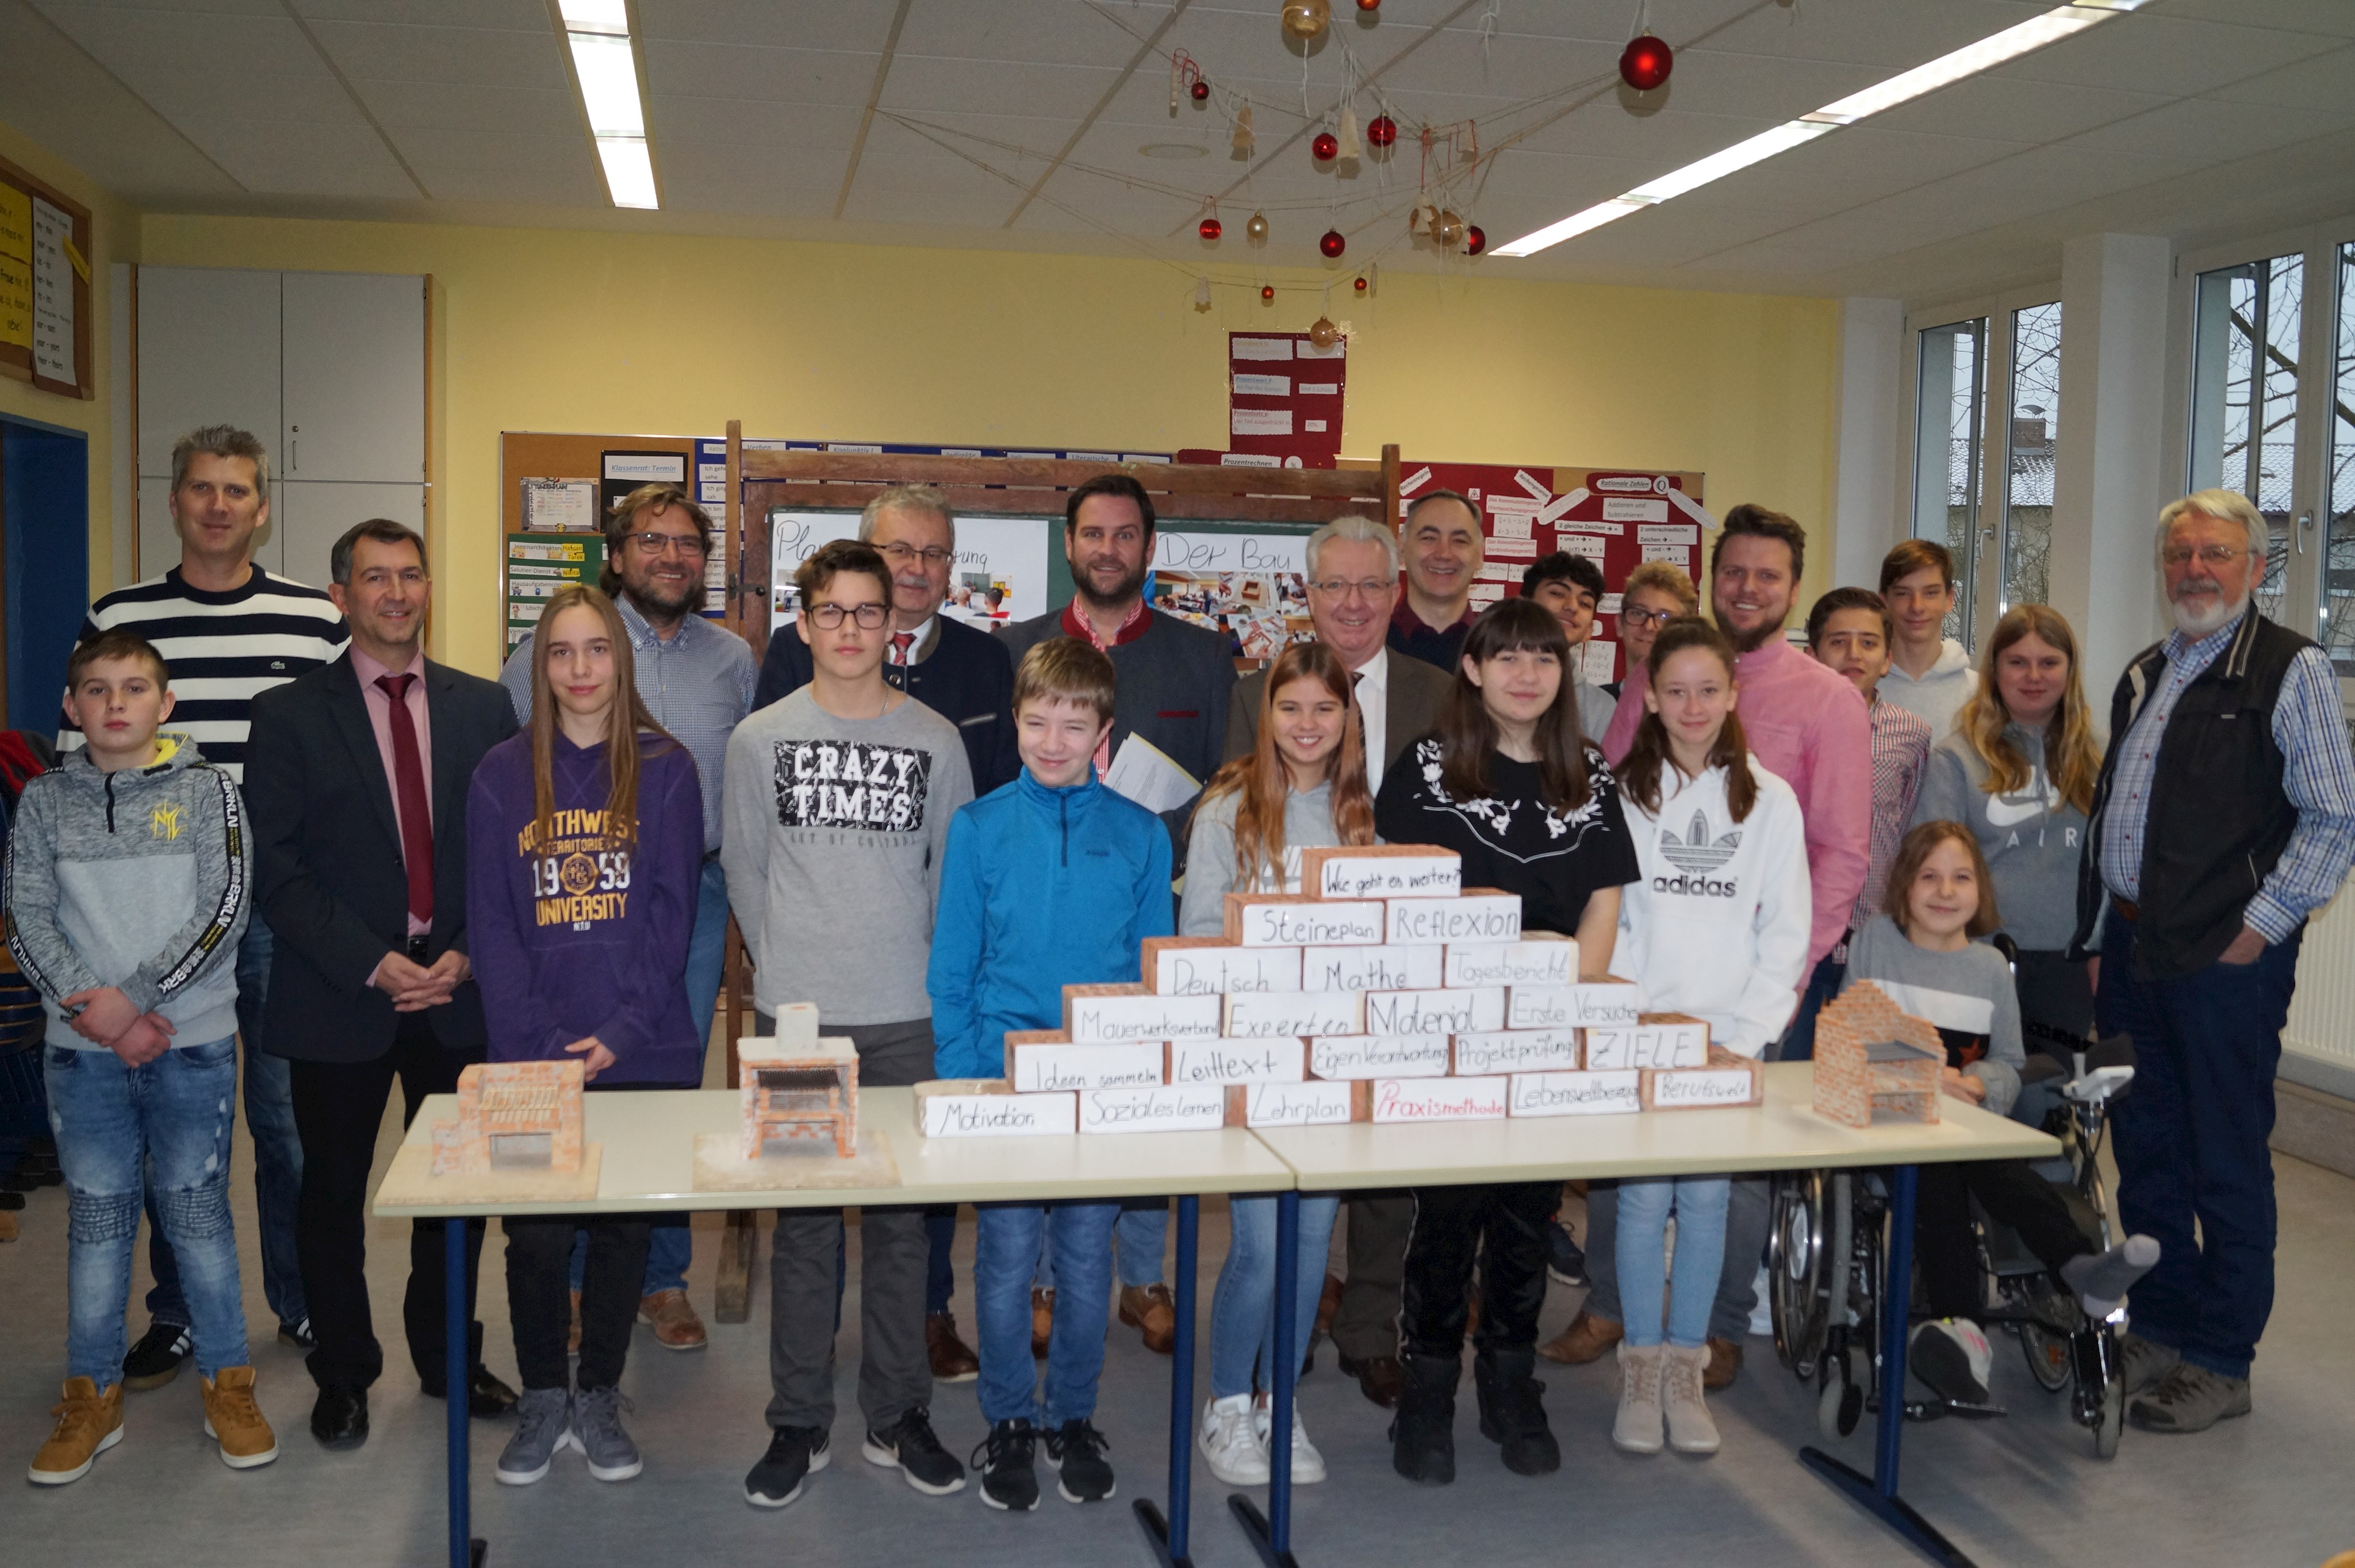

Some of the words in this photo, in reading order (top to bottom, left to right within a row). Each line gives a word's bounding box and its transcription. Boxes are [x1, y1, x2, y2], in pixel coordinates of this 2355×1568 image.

[1223, 458, 1272, 467] Prozentrechnen
[1629, 480, 1650, 488] Zahlen
[1159, 532, 1226, 569] Der
[1242, 538, 1290, 569] Bau
[795, 746, 914, 787] CRAZY
[792, 785, 912, 825] TIMES
[2006, 827, 2077, 848] AIR
[1326, 864, 1350, 894] Wie
[1356, 869, 1383, 896] geht
[1389, 875, 1403, 888] es
[1654, 875, 1736, 897] adidas
[535, 892, 628, 927] UNIVERSITY
[1262, 910, 1375, 942] Steineplan
[1396, 906, 1518, 938] Reflexion
[1174, 957, 1269, 995] Deutsch
[1325, 959, 1407, 990] Mathe
[1451, 948, 1569, 984] Tagesbericht
[1230, 1003, 1349, 1037] Experten
[1371, 992, 1478, 1035] Material
[1513, 992, 1566, 1023] Erste
[1574, 991, 1639, 1022] Versuche
[1178, 1048, 1277, 1082] Leittext
[1590, 1031, 1691, 1068] ZIELE
[1037, 1061, 1086, 1089] Ideen
[1098, 1068, 1157, 1087] sammeln
[1662, 1073, 1747, 1100] Berufswelt
[1251, 1082, 1346, 1125] Lehrplan
[1376, 1079, 1503, 1119] Praxismethode
[939, 1102, 1035, 1135] Motivation
